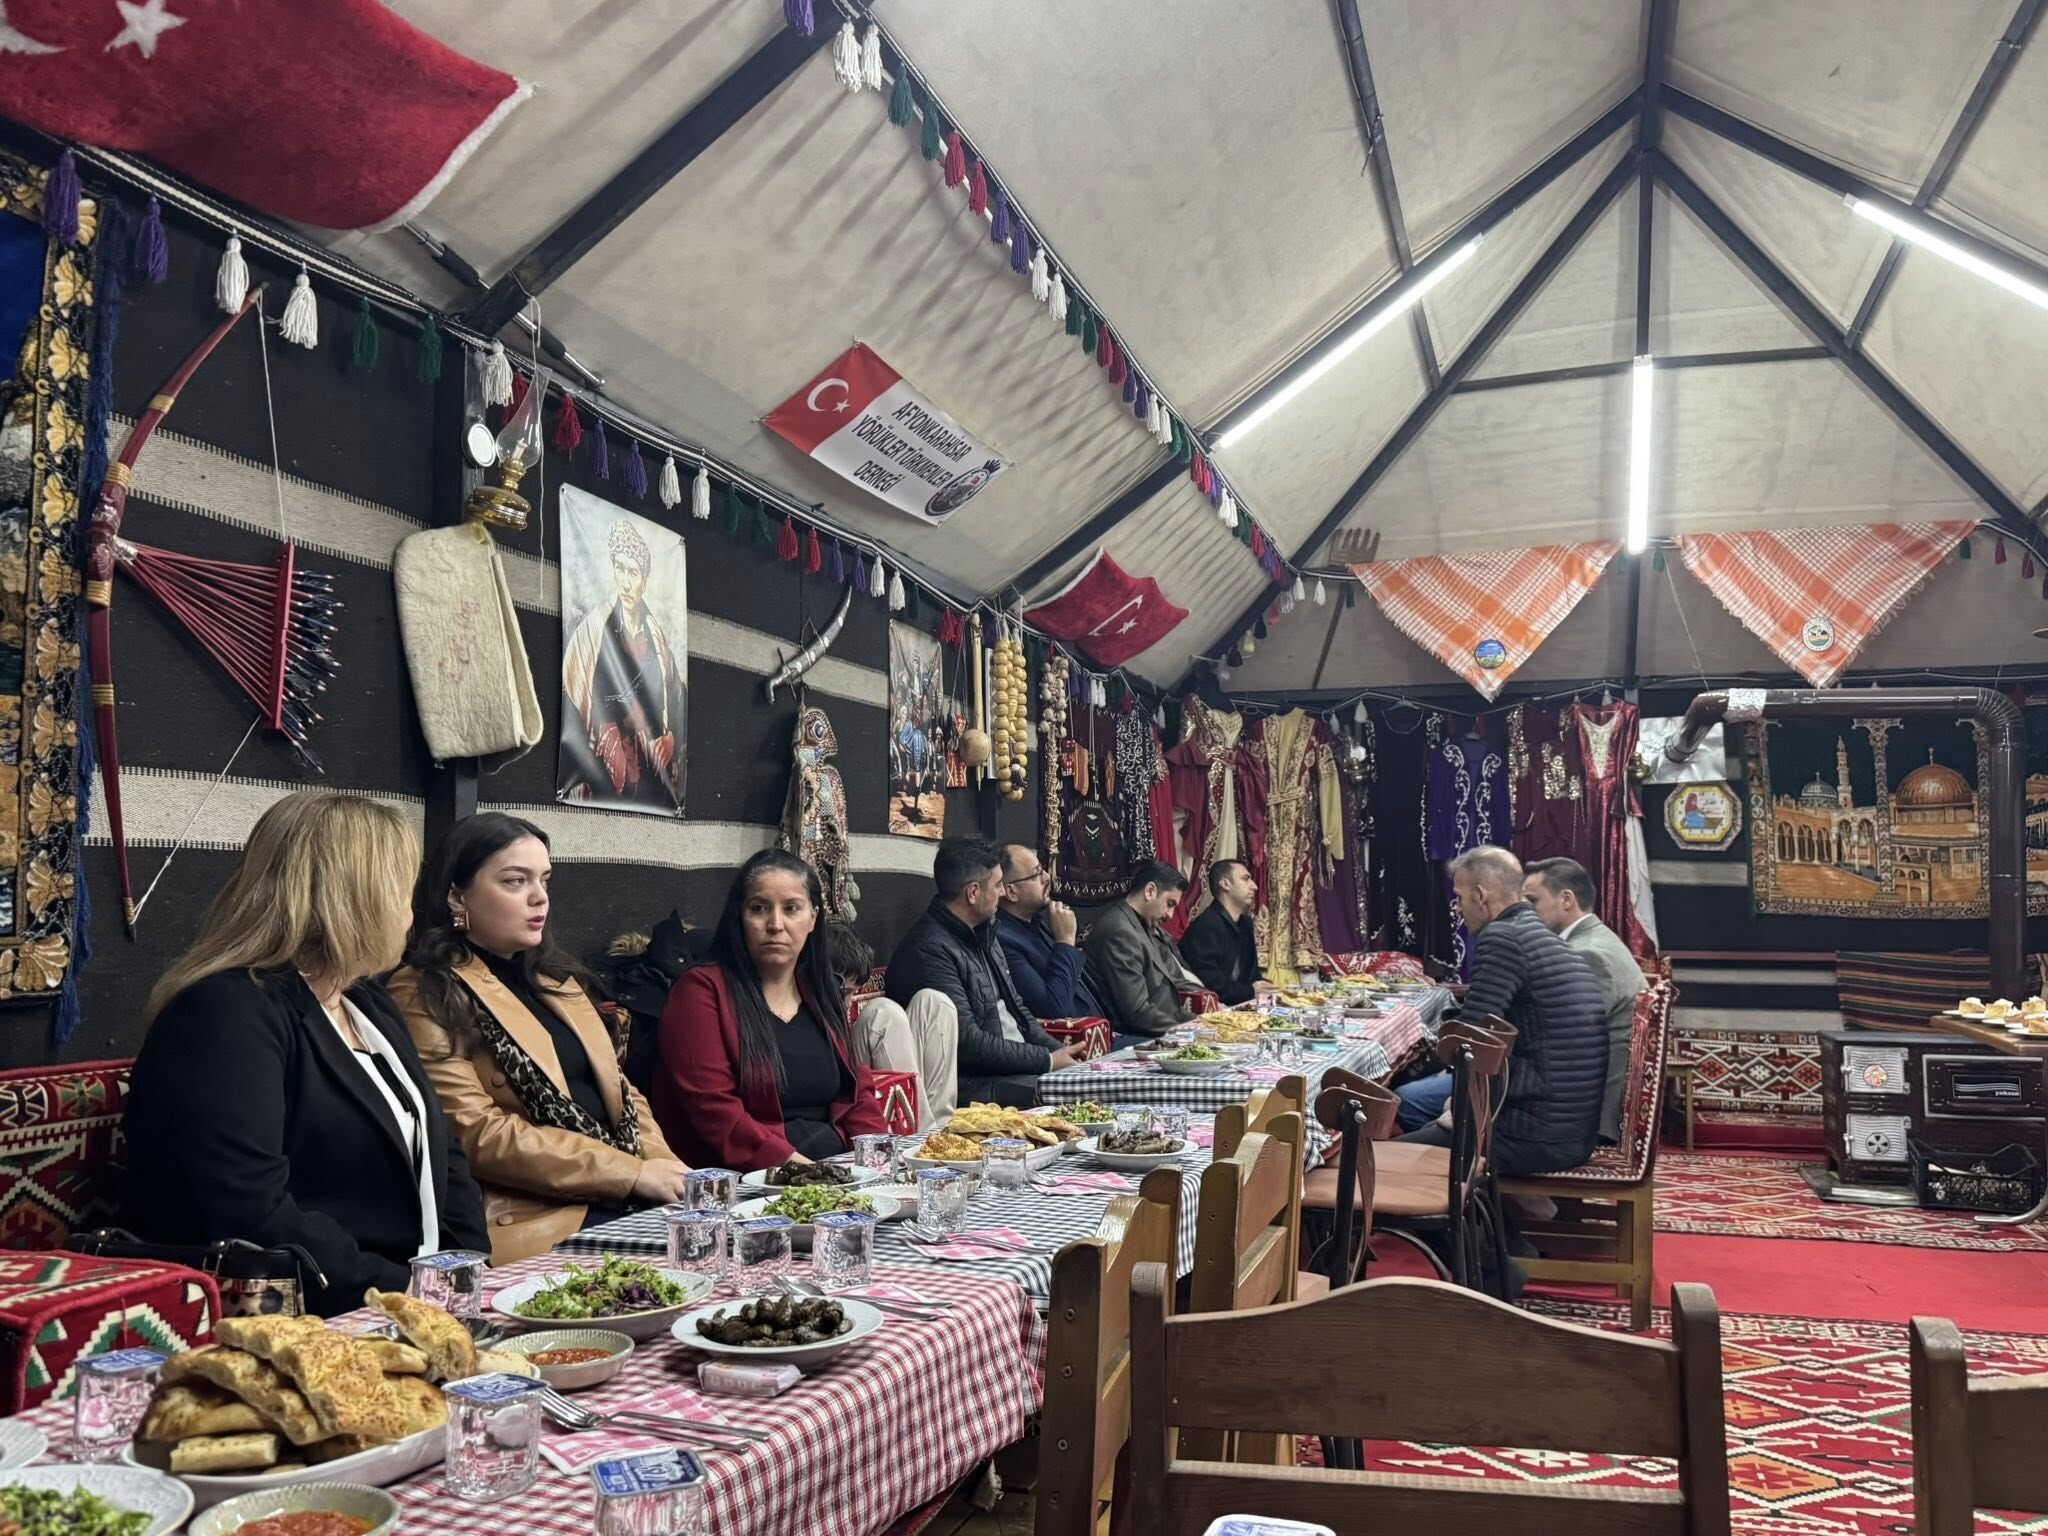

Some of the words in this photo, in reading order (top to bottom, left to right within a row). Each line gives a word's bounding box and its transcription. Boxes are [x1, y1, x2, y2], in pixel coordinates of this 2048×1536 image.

[851, 414, 908, 459] YÖRÜKLER
[894, 446, 954, 488] TÜRKMENLER
[891, 401, 972, 463] AFYONKARAHİSAR
[853, 460, 906, 493] DERNEĞİ
